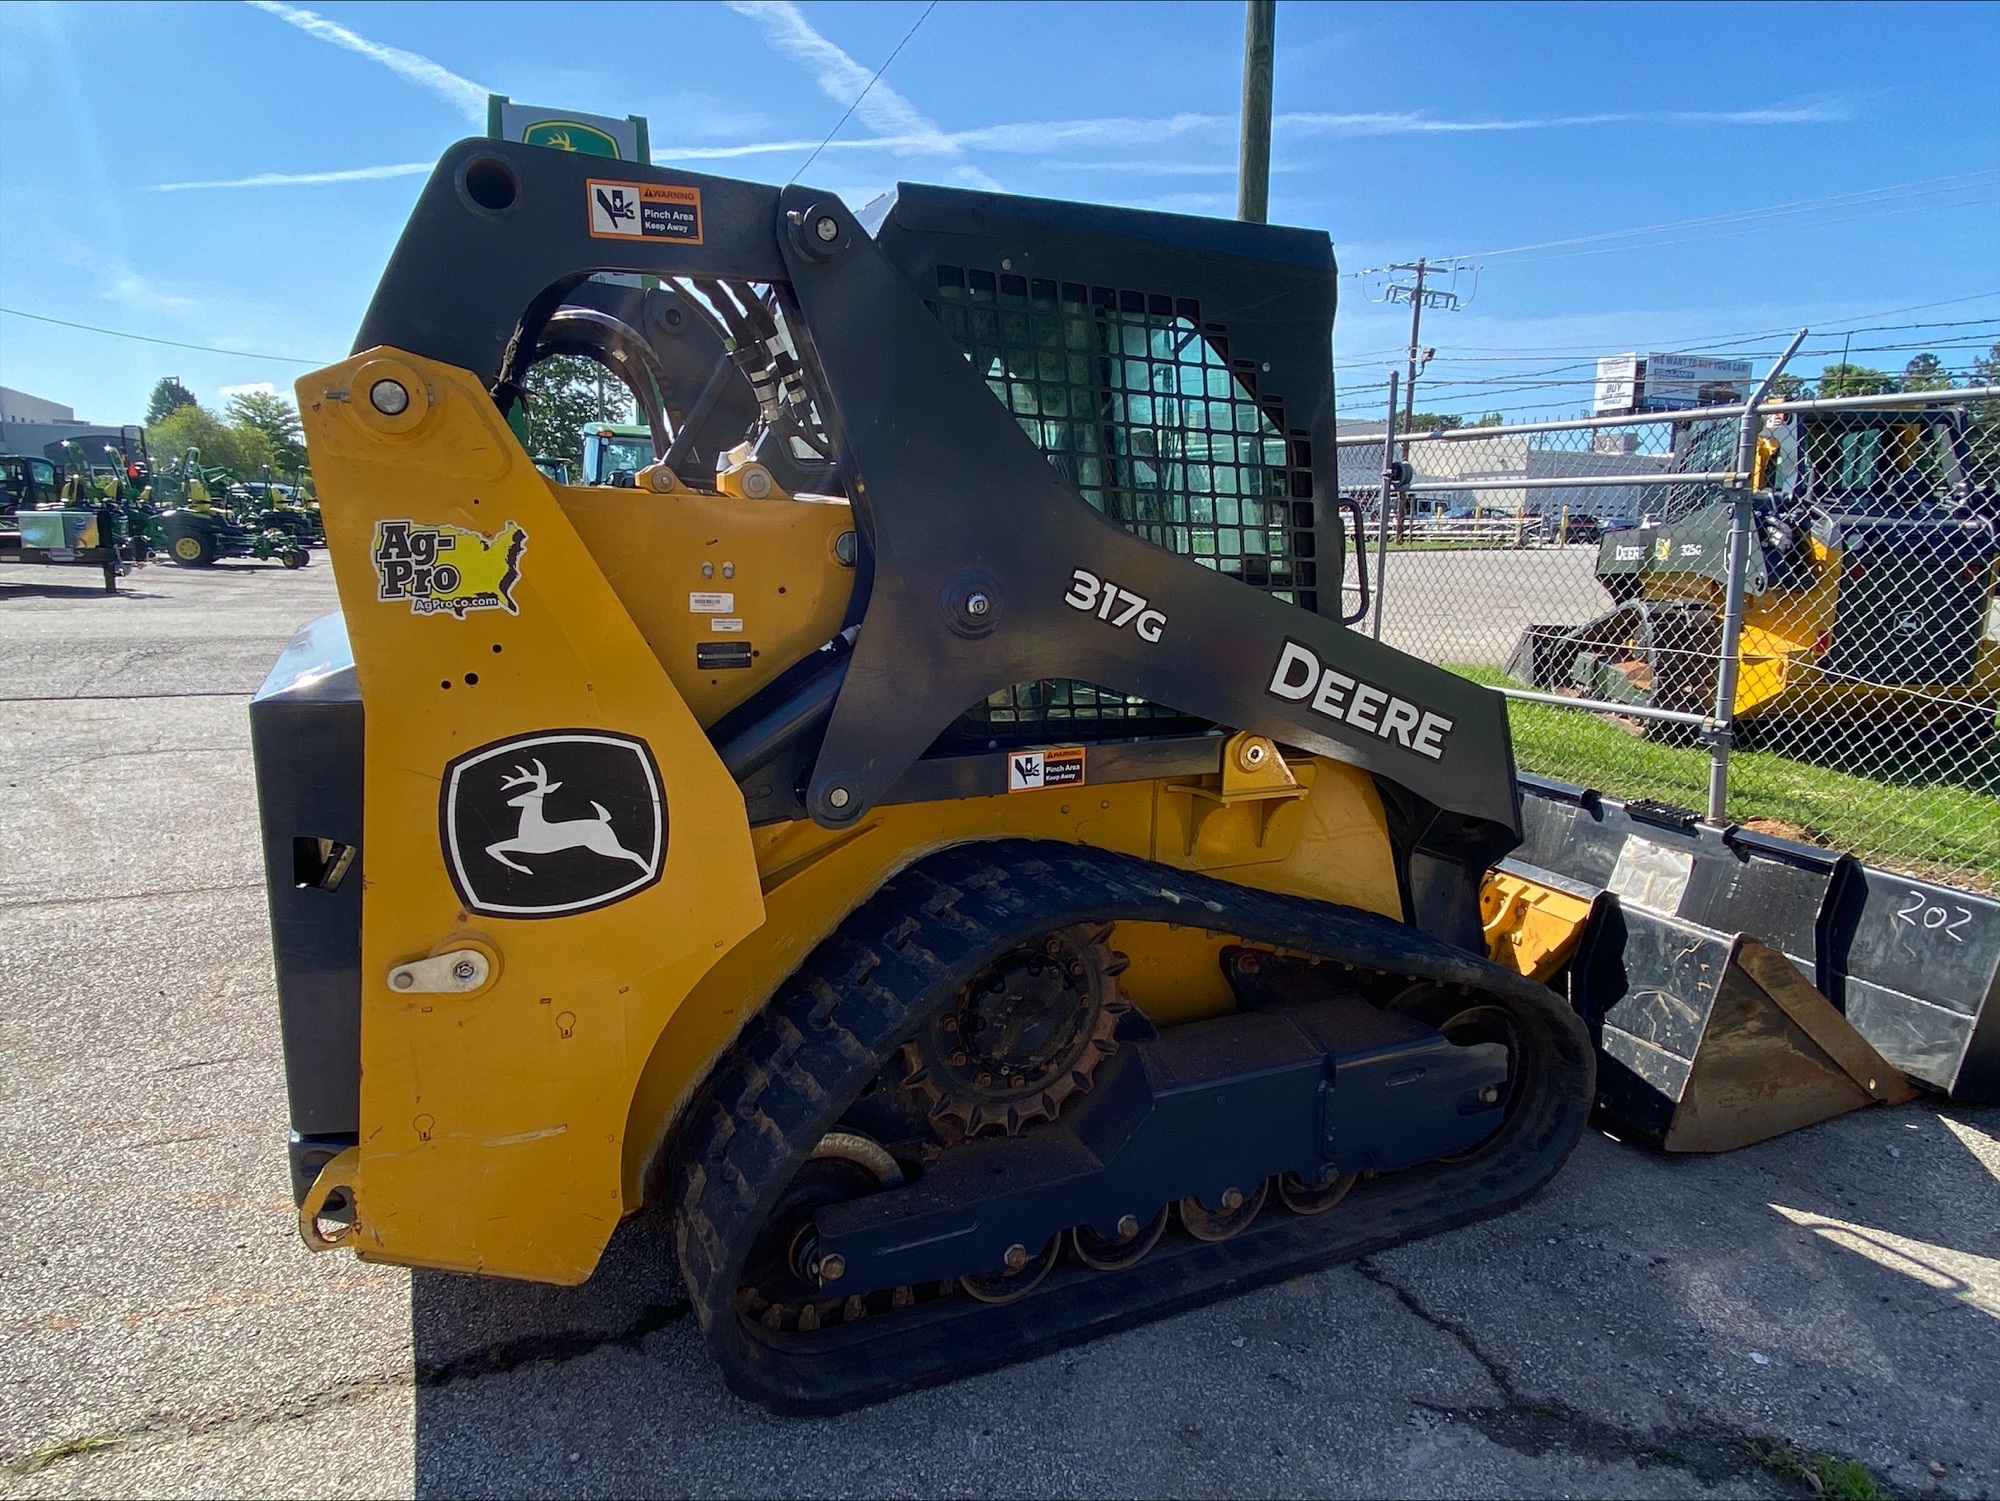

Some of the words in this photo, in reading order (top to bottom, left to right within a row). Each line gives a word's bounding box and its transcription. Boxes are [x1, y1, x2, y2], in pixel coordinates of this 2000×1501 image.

[652, 190, 695, 200] WARNING
[644, 208, 671, 220] Pinch
[672, 210, 694, 222] Area
[644, 221, 666, 231] Keep
[667, 223, 688, 234] Away
[1666, 356, 1687, 366] WANT
[1698, 359, 1713, 369] BUY
[1606, 382, 1623, 394] BUY
[376, 521, 455, 566] Ag-
[1615, 544, 1646, 561] DEERE
[381, 560, 460, 599] Pro
[415, 596, 498, 612] AgProCo.com
[1064, 569, 1168, 643] 317G
[1269, 641, 1454, 760] DEERE
[1046, 765, 1064, 773] Pinch
[1896, 890, 1973, 943] 202
